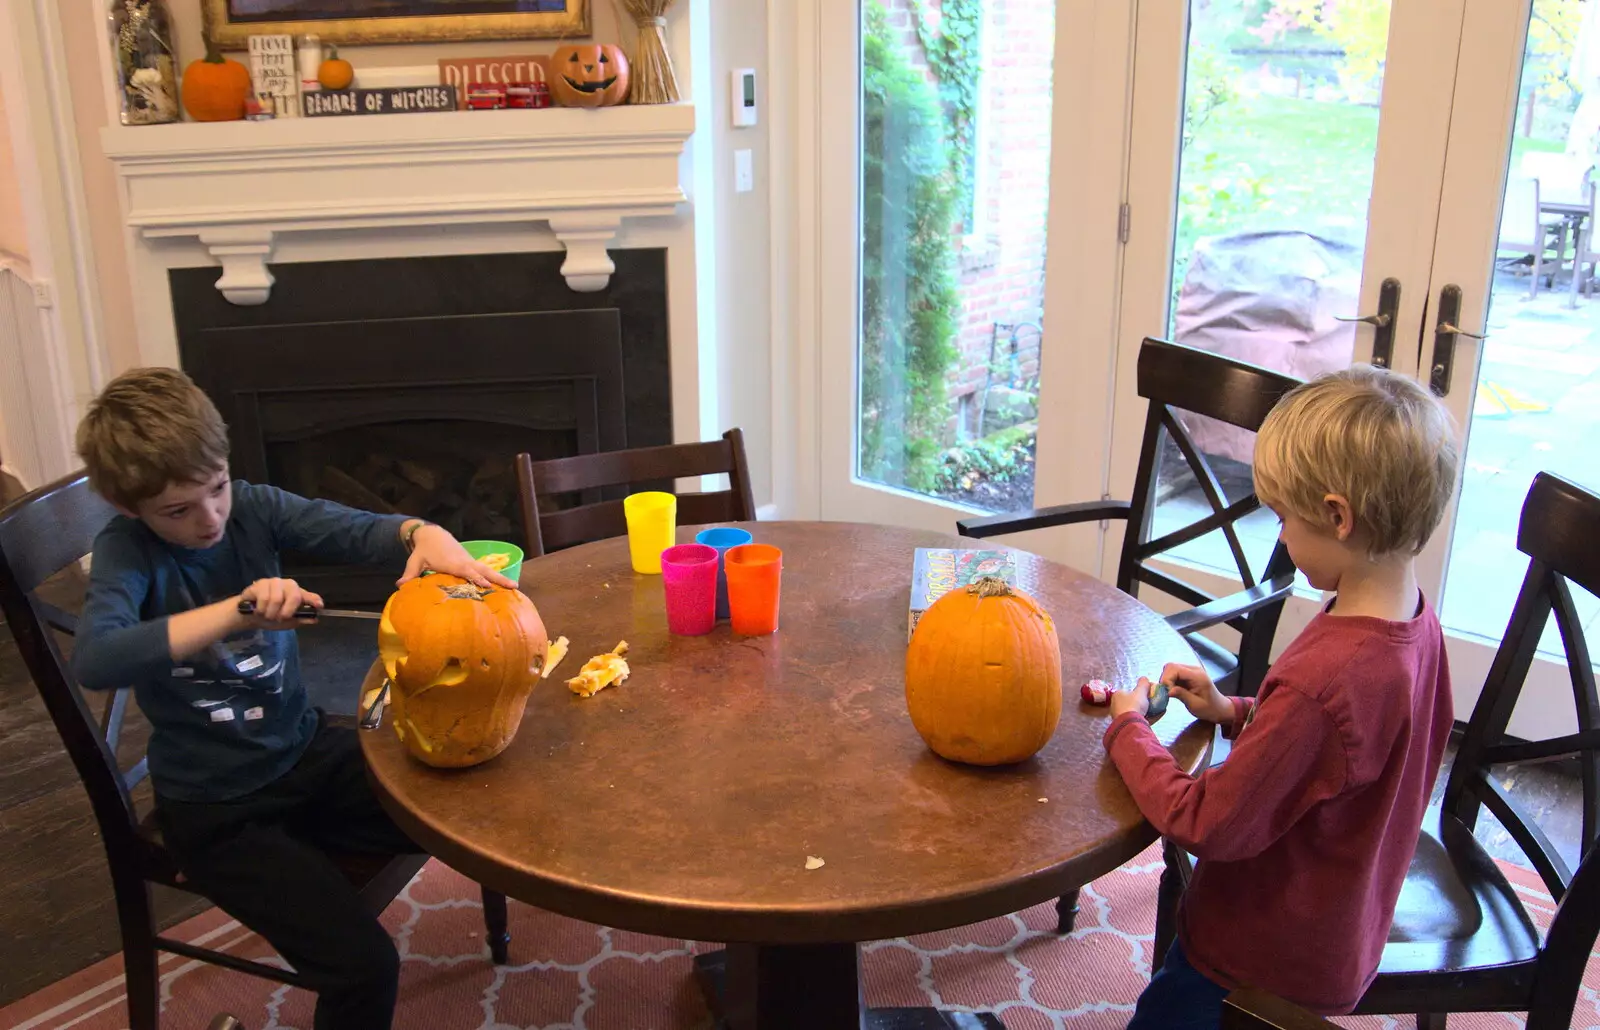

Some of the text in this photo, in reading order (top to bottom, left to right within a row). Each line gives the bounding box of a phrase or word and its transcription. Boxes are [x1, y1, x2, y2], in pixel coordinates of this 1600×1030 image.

[261, 37, 288, 50] LOVE
[306, 92, 357, 115] BEWARE
[365, 93, 383, 111] OF
[391, 87, 449, 110] WITCHES
[925, 551, 956, 583] SALE
